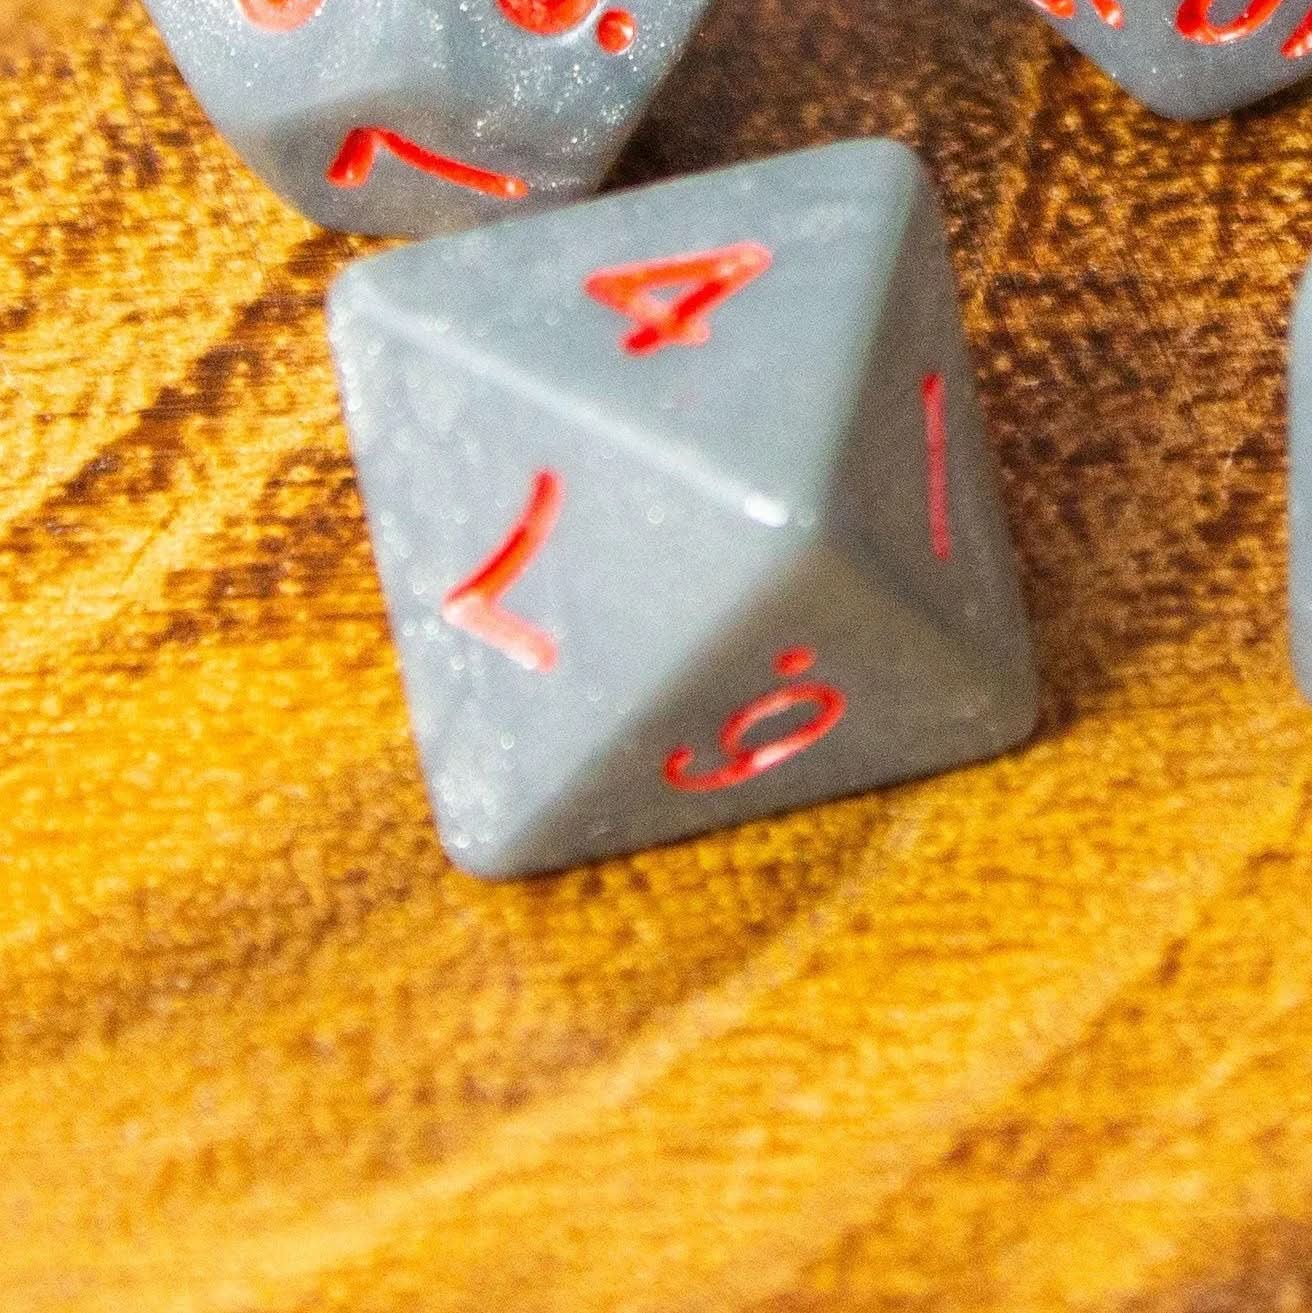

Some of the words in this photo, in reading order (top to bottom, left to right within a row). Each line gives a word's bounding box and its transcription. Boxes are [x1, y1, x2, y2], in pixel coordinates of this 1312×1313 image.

[326, 124, 530, 201] 7
[582, 241, 773, 357] 4
[441, 467, 567, 674] 7
